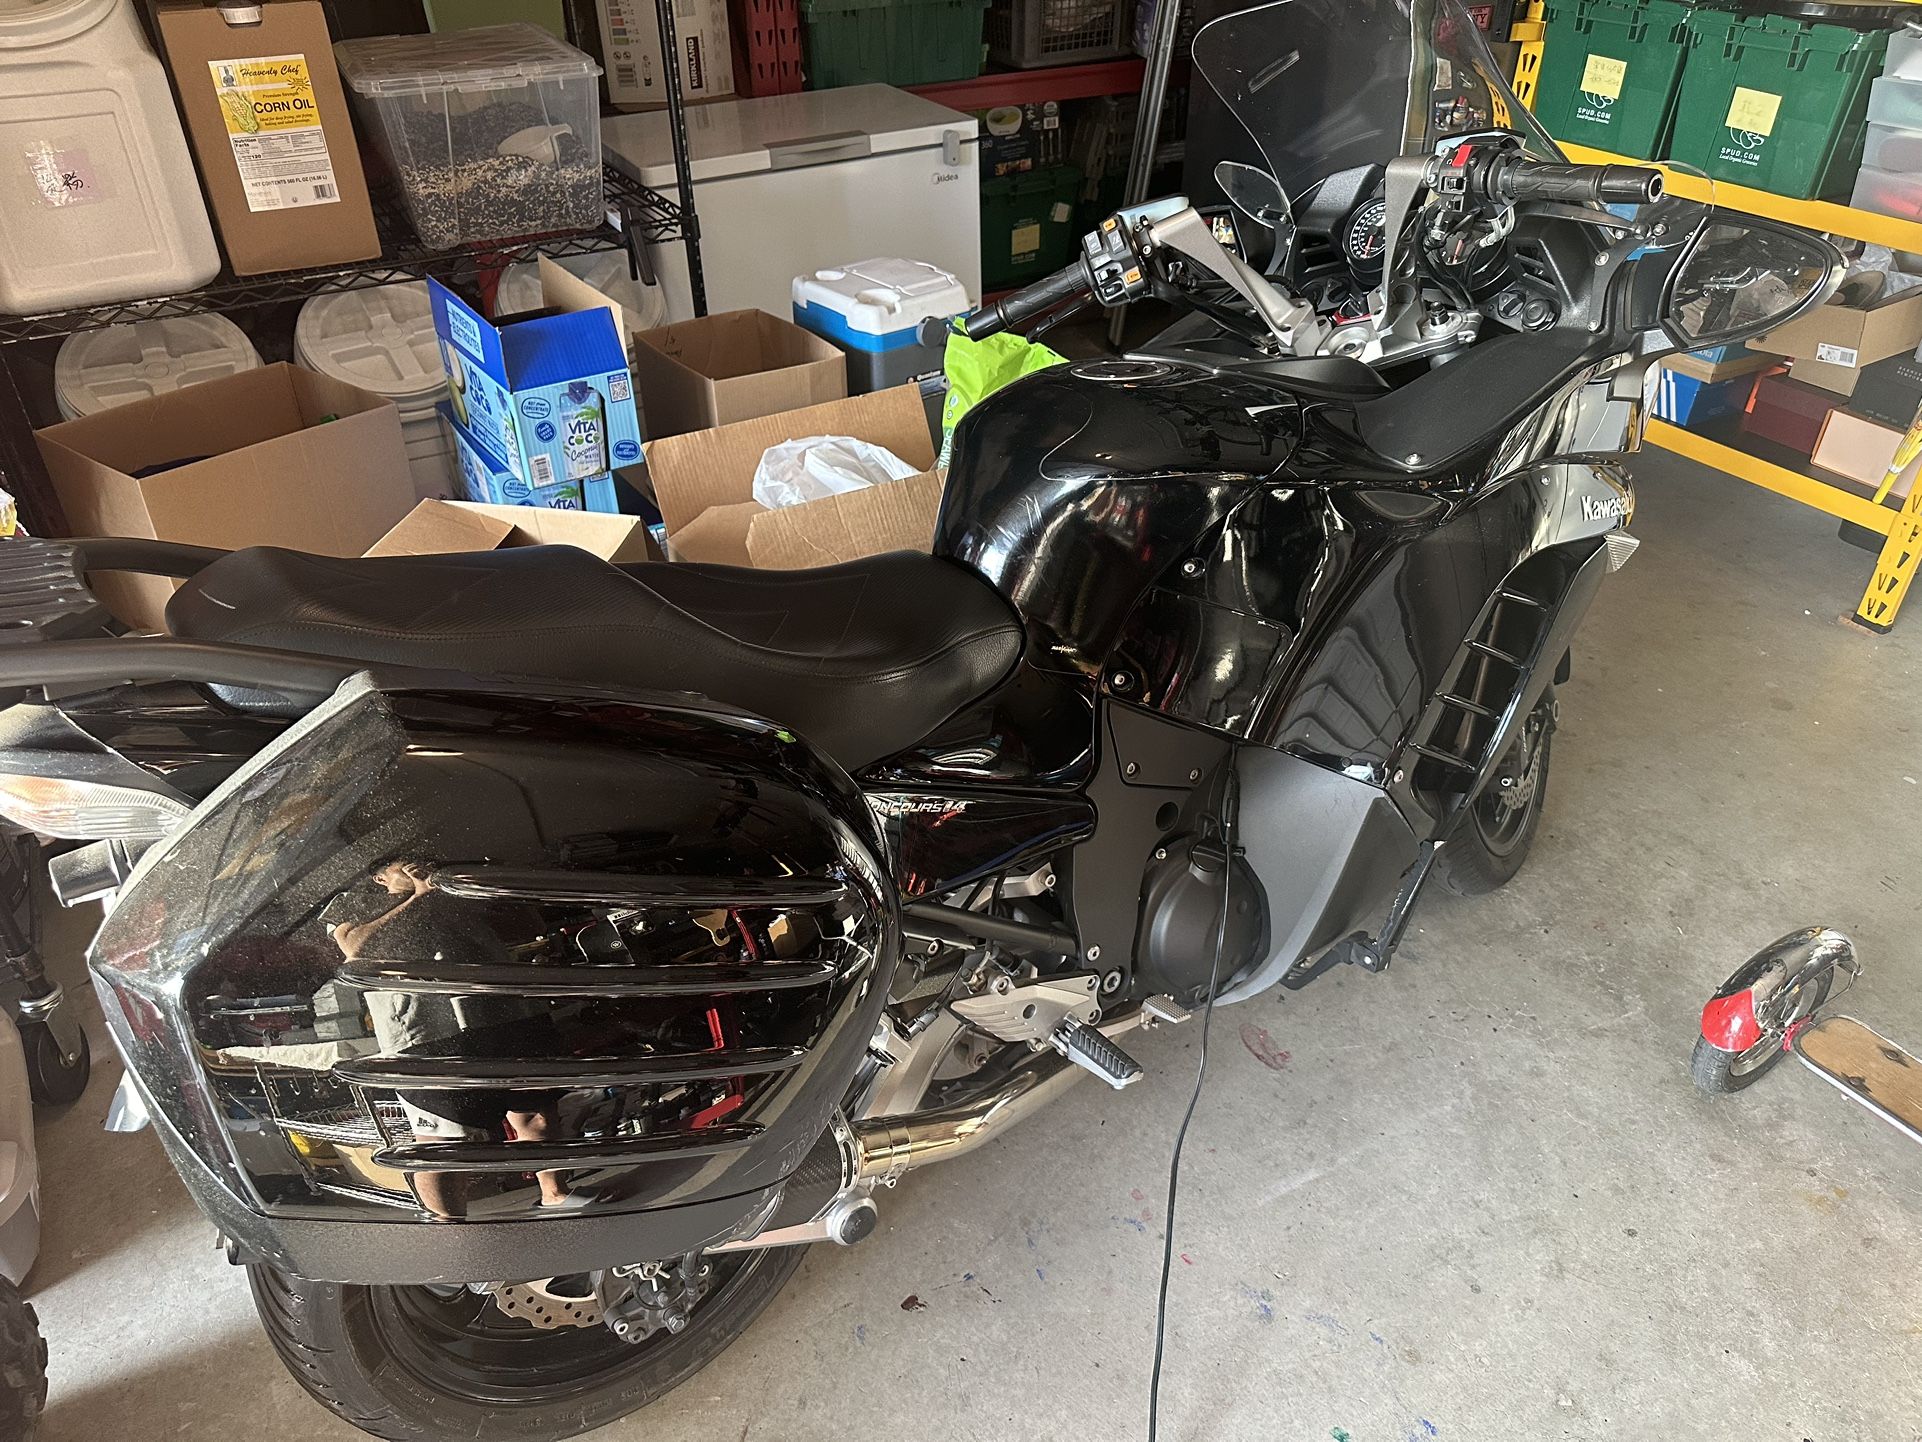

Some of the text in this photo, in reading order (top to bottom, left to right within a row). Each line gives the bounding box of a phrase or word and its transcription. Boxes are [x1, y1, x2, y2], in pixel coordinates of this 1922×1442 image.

[688, 38, 699, 88] KIRKLAND
[240, 65, 300, 77] Heavenly Chef
[253, 98, 314, 114] CORN OIL
[1578, 107, 1612, 119] SPUD.COM
[1721, 147, 1760, 161] SPUD.COM
[568, 420, 597, 434] VITA
[568, 433, 601, 446] COCO
